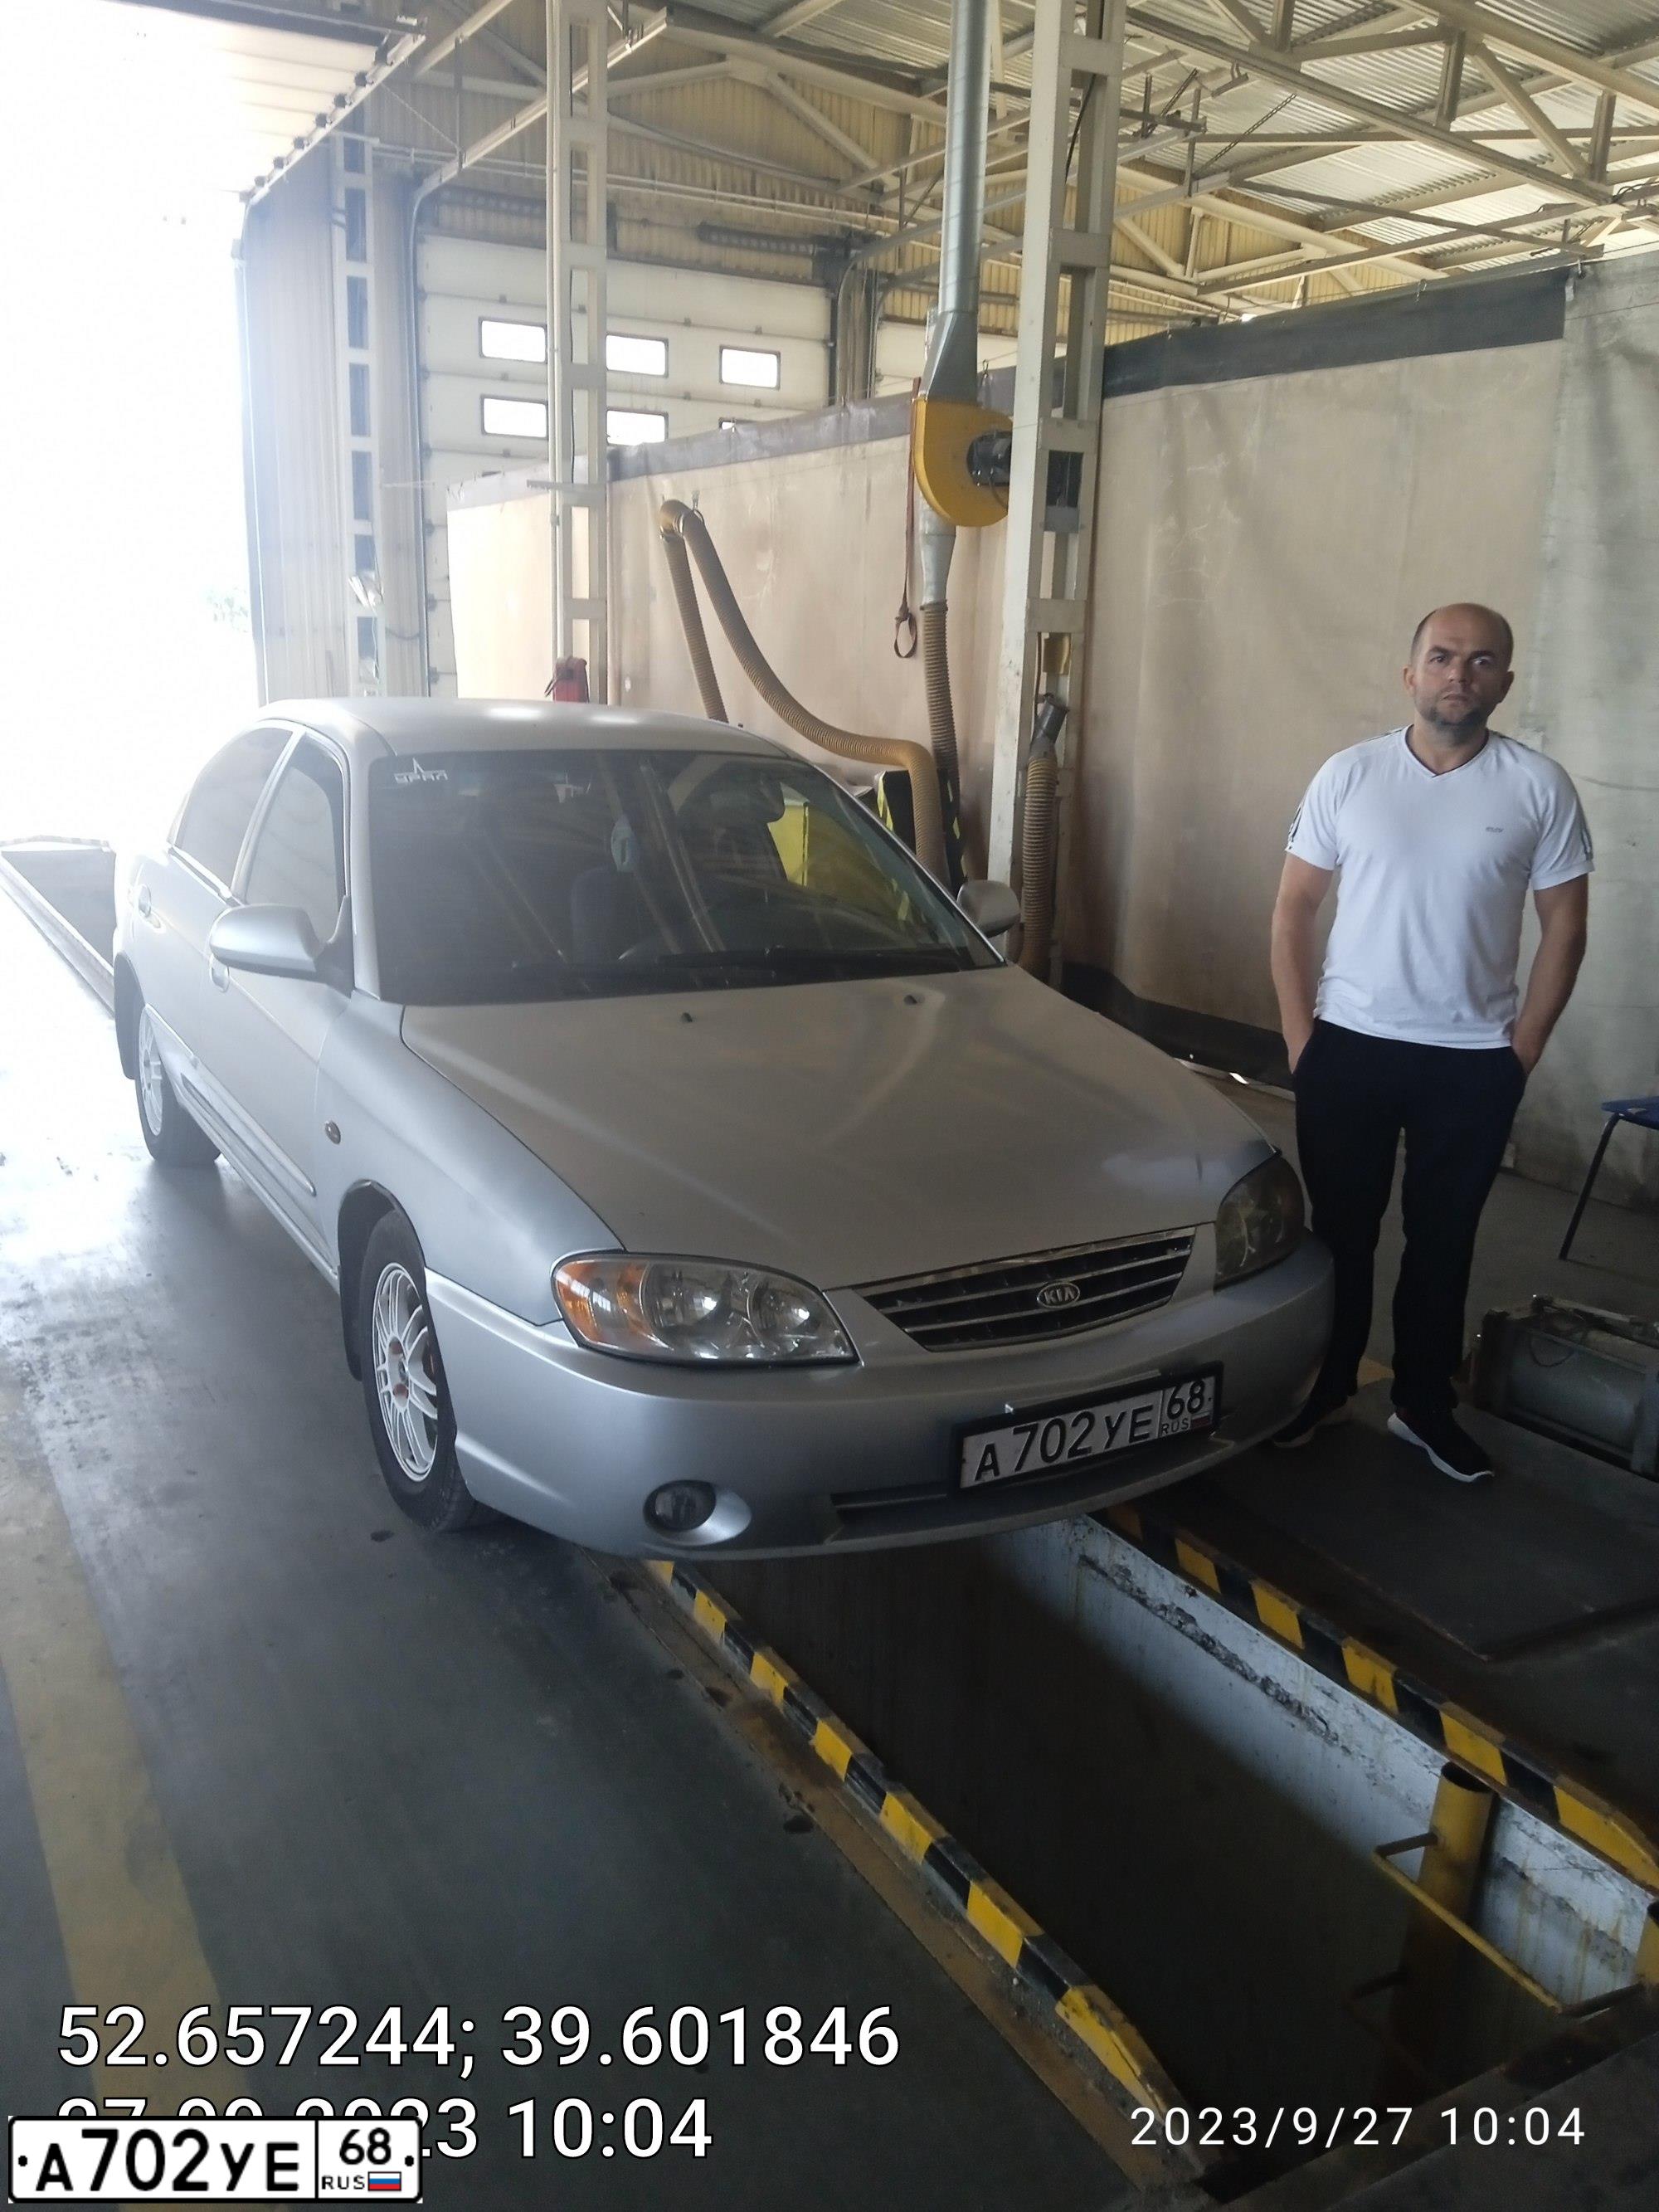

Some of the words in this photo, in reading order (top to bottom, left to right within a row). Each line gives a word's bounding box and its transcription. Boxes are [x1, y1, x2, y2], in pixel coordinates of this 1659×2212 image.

[1044, 1287, 1075, 1304] KIA
[974, 1405, 1154, 1482] А702УЕ
[1165, 1380, 1206, 1420] 68
[1160, 1420, 1190, 1435] RUS
